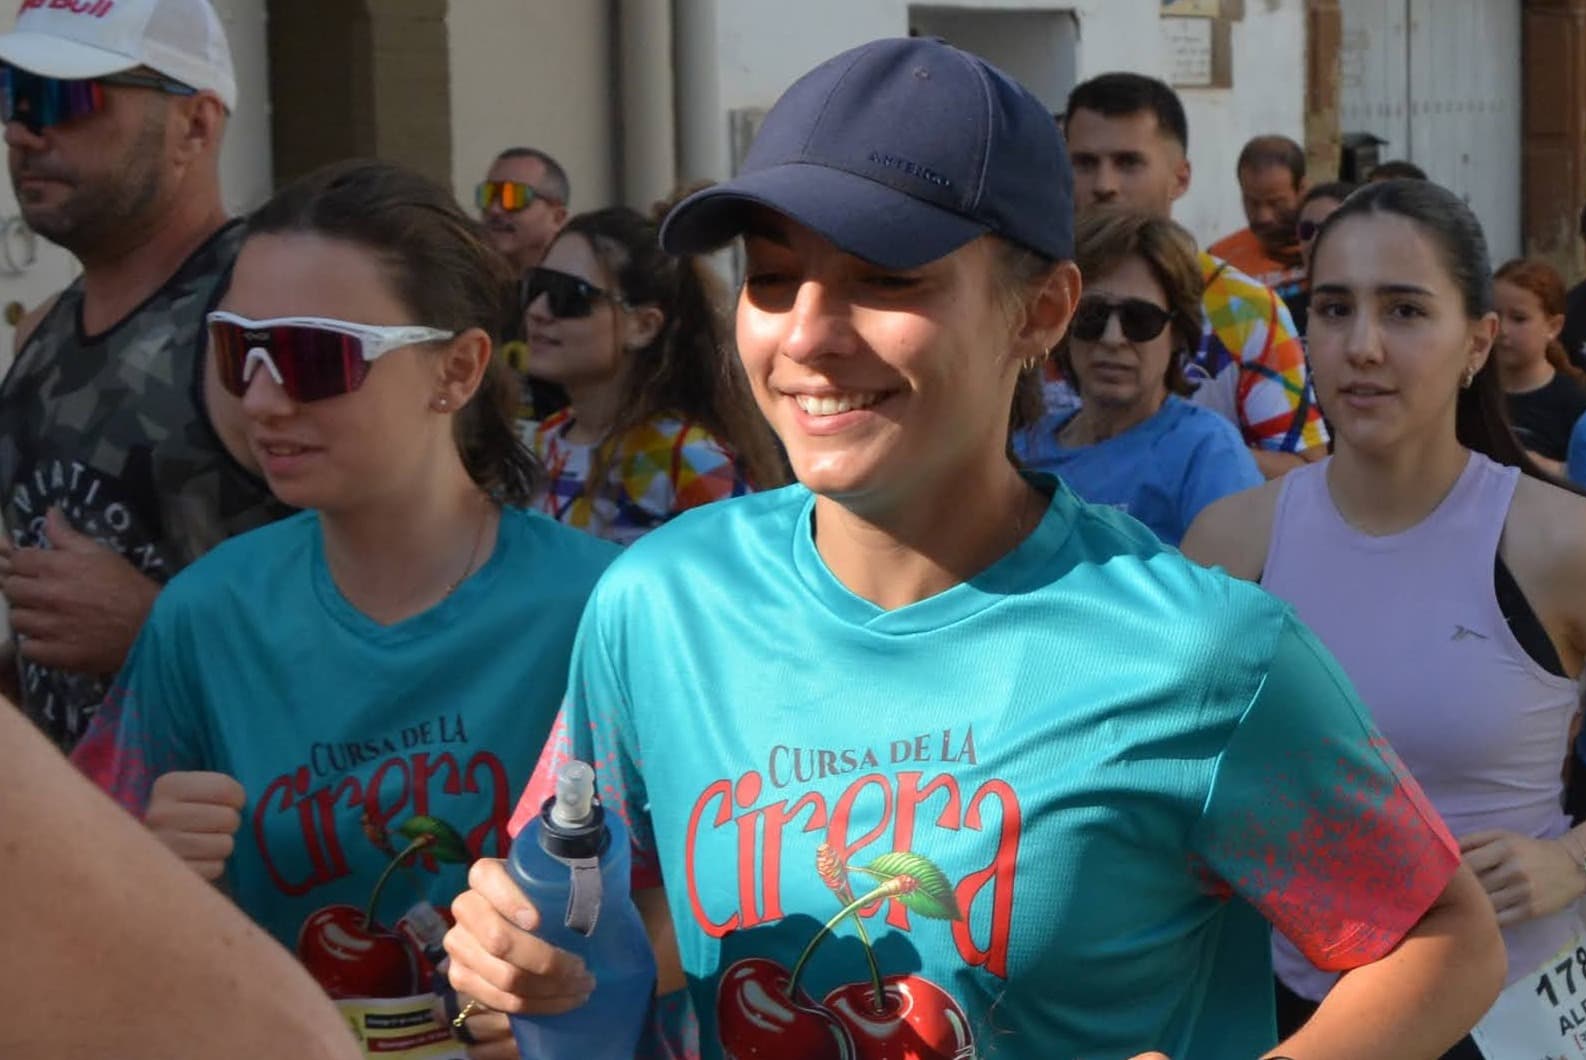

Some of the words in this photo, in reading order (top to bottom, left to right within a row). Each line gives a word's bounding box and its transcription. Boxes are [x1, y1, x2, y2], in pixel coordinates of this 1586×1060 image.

[310, 740, 398, 777] CURSA
[401, 721, 434, 751] DE
[438, 713, 469, 744] LA
[768, 744, 879, 789] CURSA
[889, 733, 931, 764] DE
[938, 721, 978, 765] LA
